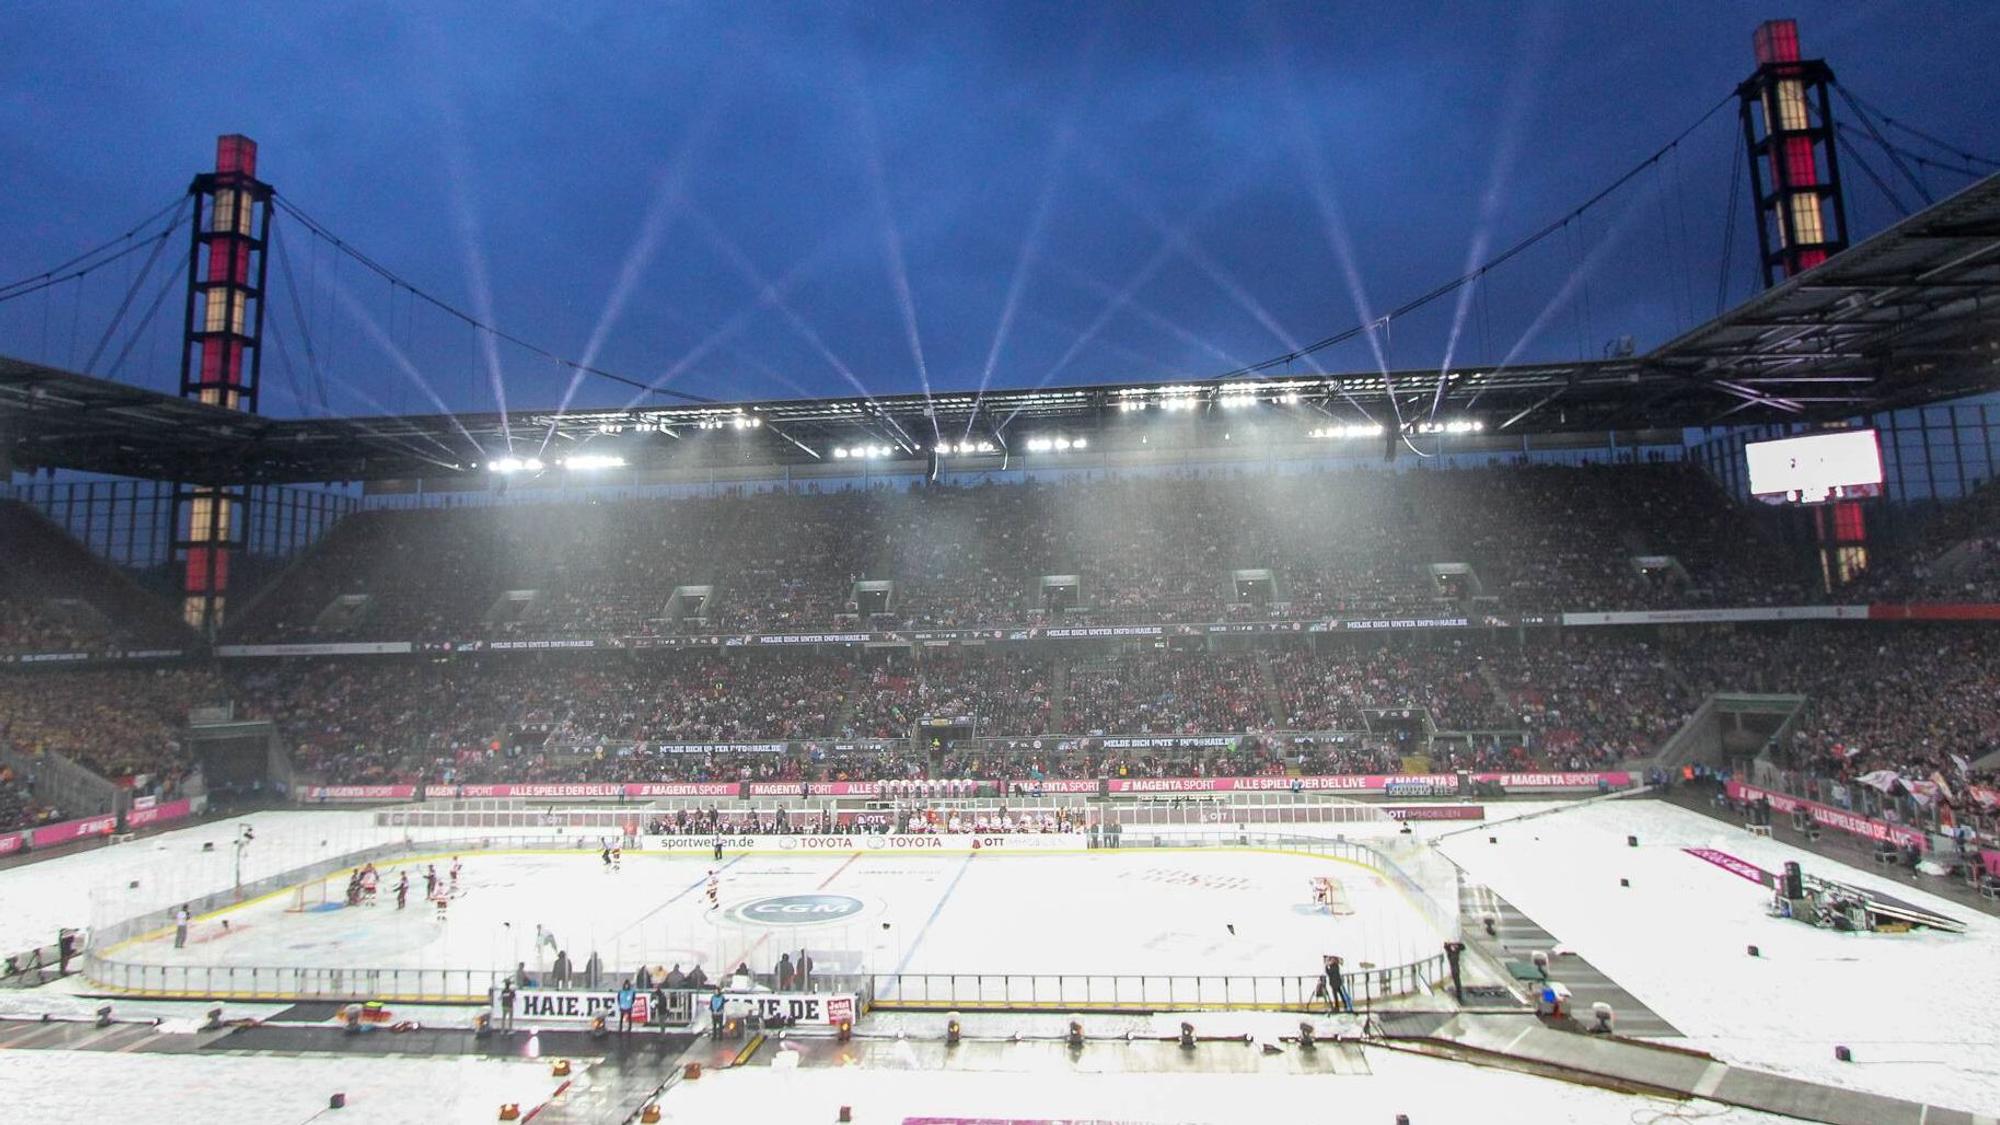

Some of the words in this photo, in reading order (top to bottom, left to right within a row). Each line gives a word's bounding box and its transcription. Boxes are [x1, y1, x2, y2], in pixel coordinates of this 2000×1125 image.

[1233, 778, 1260, 789] ALLE
[1321, 778, 1341, 788] DEL
[1343, 777, 1366, 788] LIVE
[1511, 774, 1565, 784] MAGENTA
[1565, 774, 1599, 784] SPORT
[651, 785, 698, 795] MAGENTA
[698, 785, 728, 795] SPORT
[755, 784, 801, 794] MAGENTA
[804, 784, 832, 794] PORT
[847, 783, 872, 793] ALLE
[1069, 781, 1100, 792] SPORT
[1132, 780, 1182, 790] MAGENTA
[1183, 780, 1216, 789] SPORT
[425, 786, 464, 796] MAGENT
[466, 786, 493, 796] SPORT
[509, 786, 533, 796] ALLE
[533, 786, 565, 795] SPIELE
[566, 786, 585, 795] DER
[585, 786, 605, 795] DEL
[605, 785, 624, 795] LIV
[1388, 810, 1407, 818] OTT
[800, 838, 853, 848] TOYOTA
[889, 837, 942, 847] TOYOTA
[984, 838, 1004, 846] OTT
[754, 903, 853, 913] CGM
[523, 996, 616, 1017] HAIE.DE
